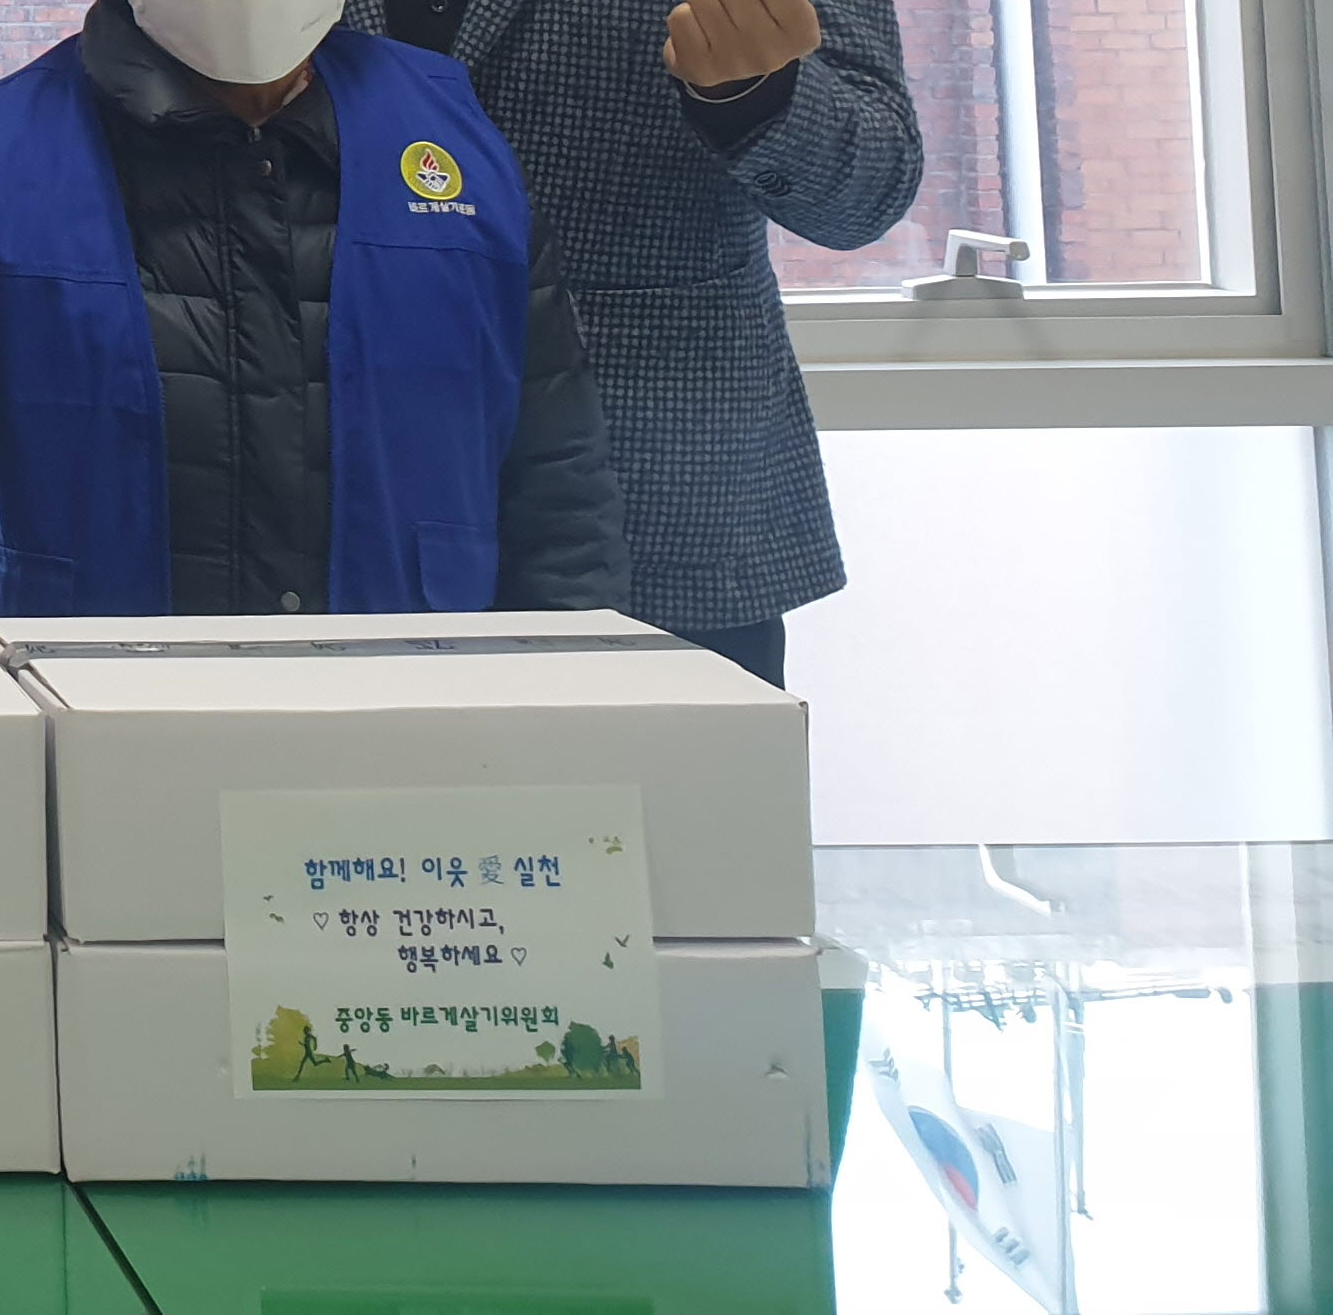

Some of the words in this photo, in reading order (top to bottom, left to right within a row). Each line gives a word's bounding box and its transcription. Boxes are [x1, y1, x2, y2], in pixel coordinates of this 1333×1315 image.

[304, 857, 405, 890] 함께해요!
[422, 857, 468, 887] 이웃
[478, 855, 504, 884] 愛
[514, 855, 560, 887] 실천
[339, 909, 379, 936] 항상
[393, 908, 504, 936] 건강하시고,
[398, 944, 502, 973] 행복하세요
[335, 1007, 393, 1033] 중앙동
[401, 1006, 558, 1032] 바르게살기위원회
